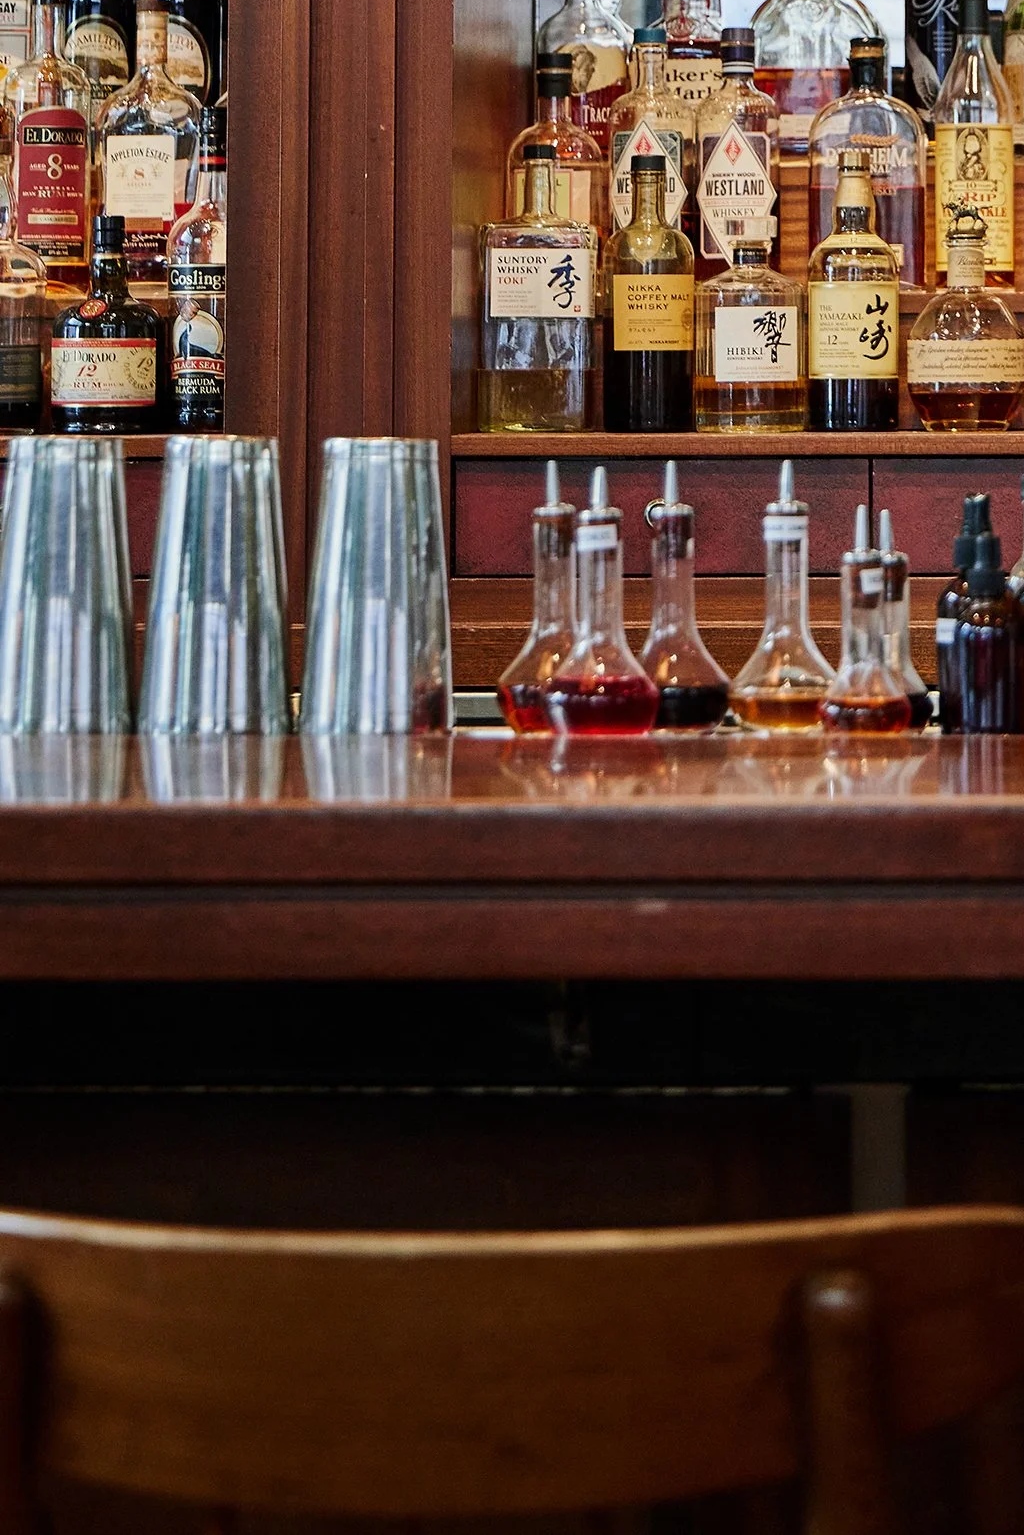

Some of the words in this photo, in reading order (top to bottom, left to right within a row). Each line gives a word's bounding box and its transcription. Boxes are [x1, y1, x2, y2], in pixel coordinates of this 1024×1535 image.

[41, 127, 84, 144] DORADO
[110, 147, 145, 164] APPLETON
[145, 147, 172, 164] ESTATE
[47, 153, 63, 180] 8
[704, 179, 766, 197] WESTLAND
[711, 208, 758, 218] WHISKEY
[497, 255, 549, 265] SUNTORY
[497, 266, 541, 275] WHISKY
[170, 269, 226, 290] Goslings
[497, 275, 526, 286] TOKI
[627, 284, 662, 292] NIKKA
[627, 293, 668, 302] COFFEY
[670, 293, 691, 302] MALT
[627, 303, 669, 311] WHISKY
[819, 312, 863, 321] YAMAZAKI
[826, 335, 838, 346] 12
[73, 349, 117, 363] DORADO
[726, 347, 764, 356] HIBIKI
[137, 358, 154, 369] 12
[173, 361, 198, 371] BLACK
[198, 360, 222, 371] SEAL
[77, 364, 98, 378] 12
[73, 381, 102, 389] RUM
[177, 377, 216, 386] BERMUDA
[175, 385, 199, 394] BLACK
[199, 385, 220, 394] RUM
